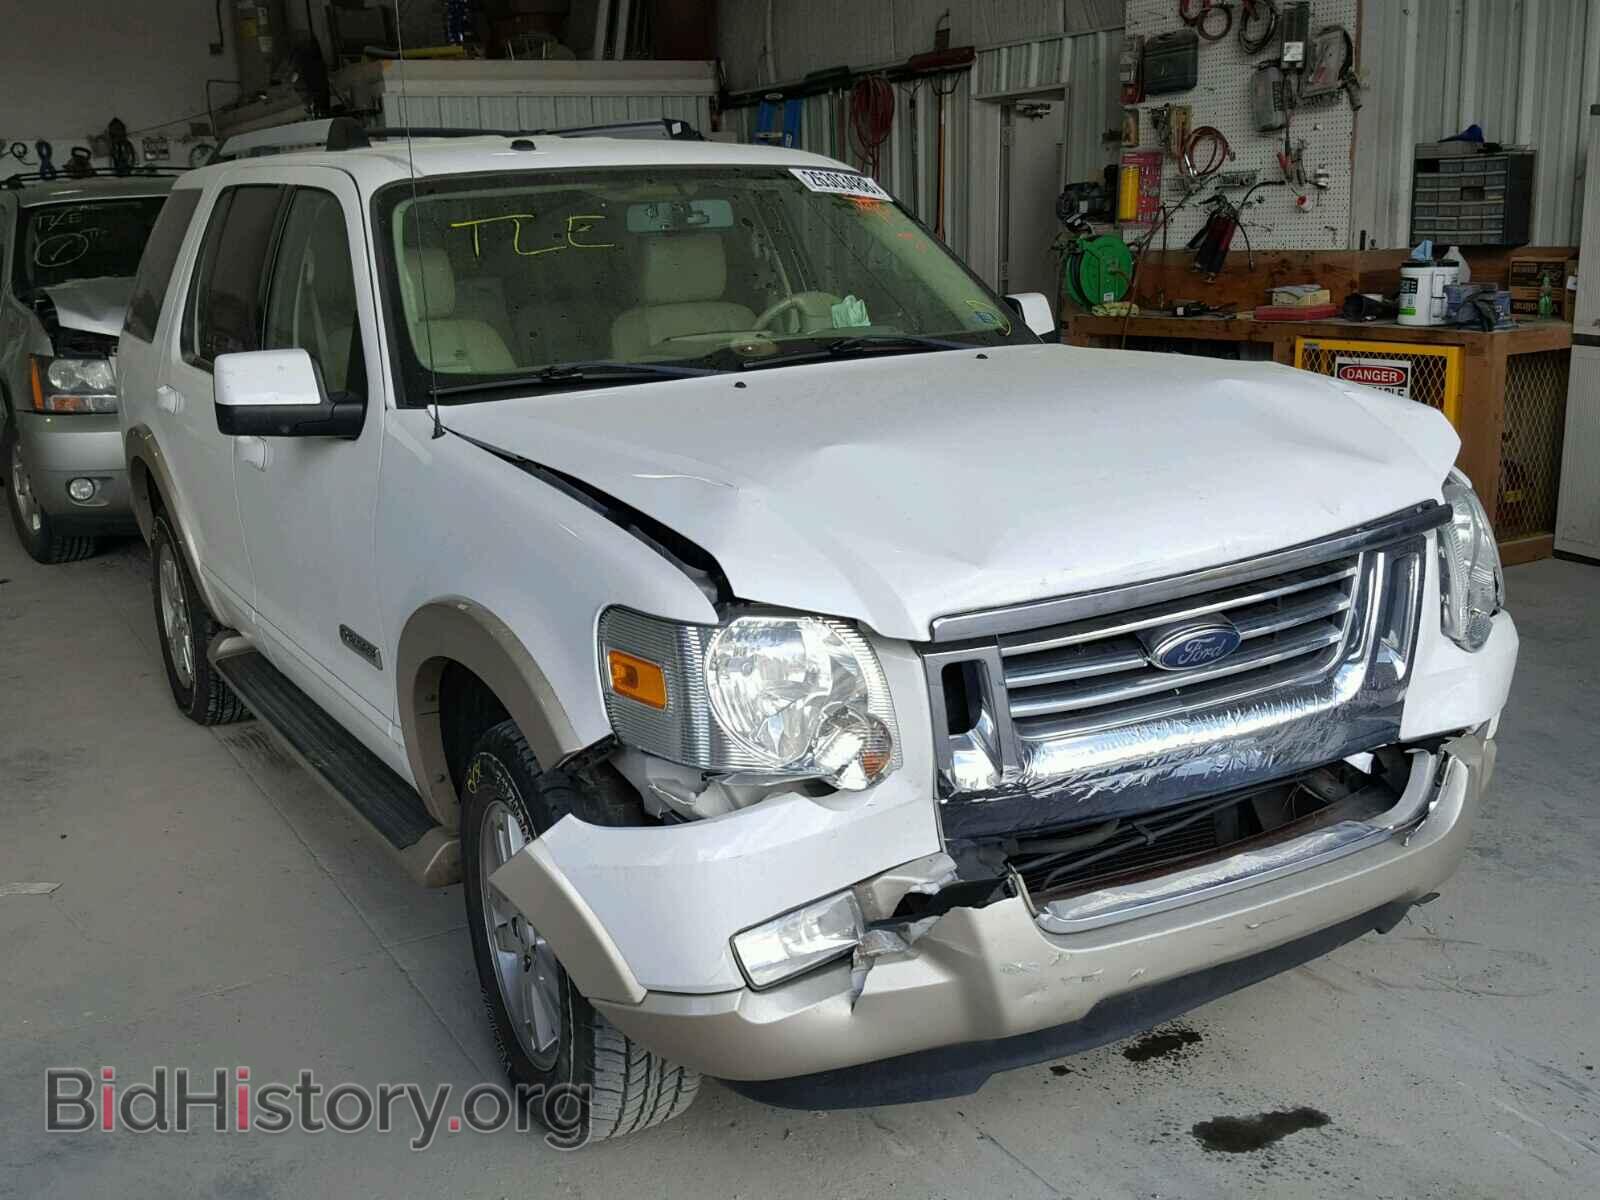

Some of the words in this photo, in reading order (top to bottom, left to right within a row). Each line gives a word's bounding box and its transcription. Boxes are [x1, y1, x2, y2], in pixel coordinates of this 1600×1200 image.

[450, 214, 615, 257] TLE
[1346, 368, 1398, 382] DANGER
[1177, 635, 1226, 665] Ford
